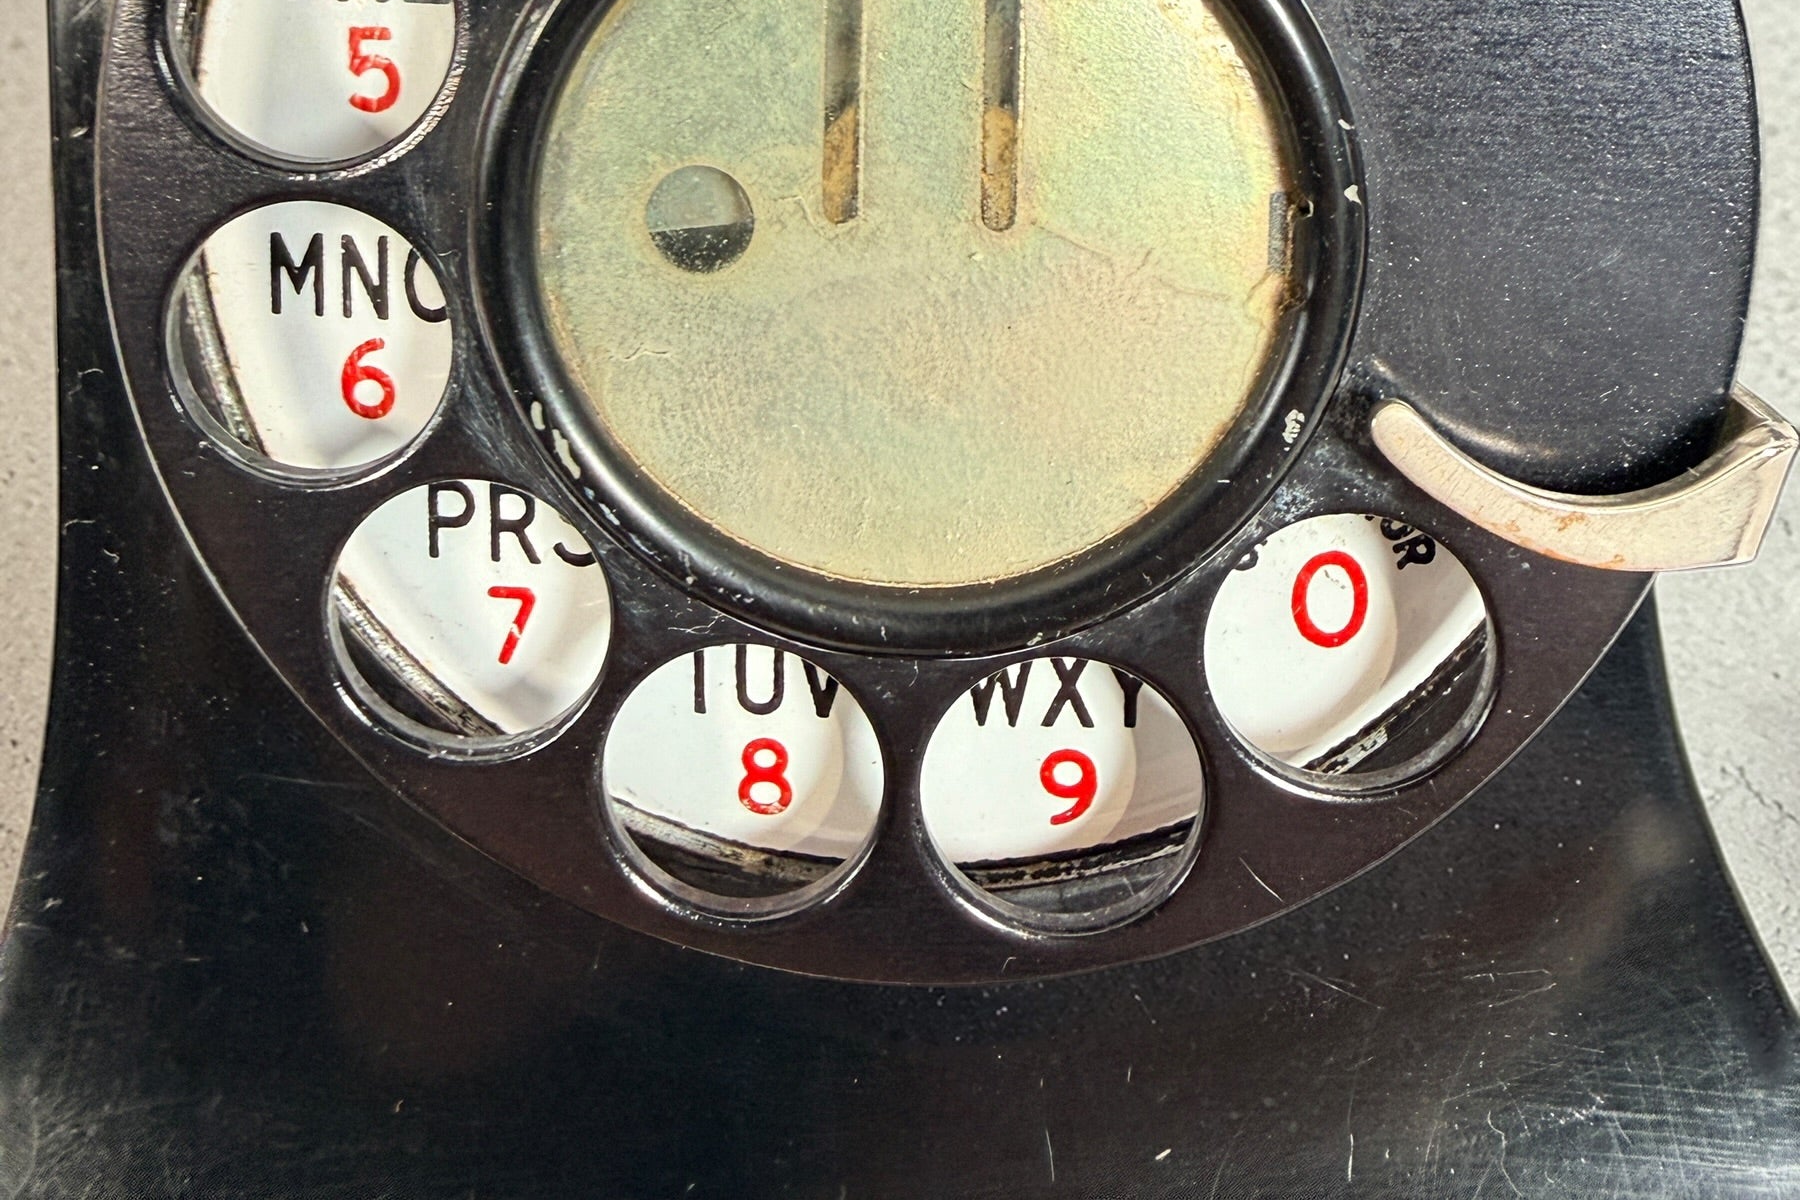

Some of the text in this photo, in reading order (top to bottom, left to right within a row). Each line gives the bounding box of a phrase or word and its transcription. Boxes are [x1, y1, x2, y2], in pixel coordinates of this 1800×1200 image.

[348, 26, 401, 113] 5
[341, 338, 396, 420] 6
[487, 586, 537, 665] 7
[1291, 550, 1369, 648] 0
[737, 737, 793, 815] 8
[1039, 748, 1098, 826] 9
